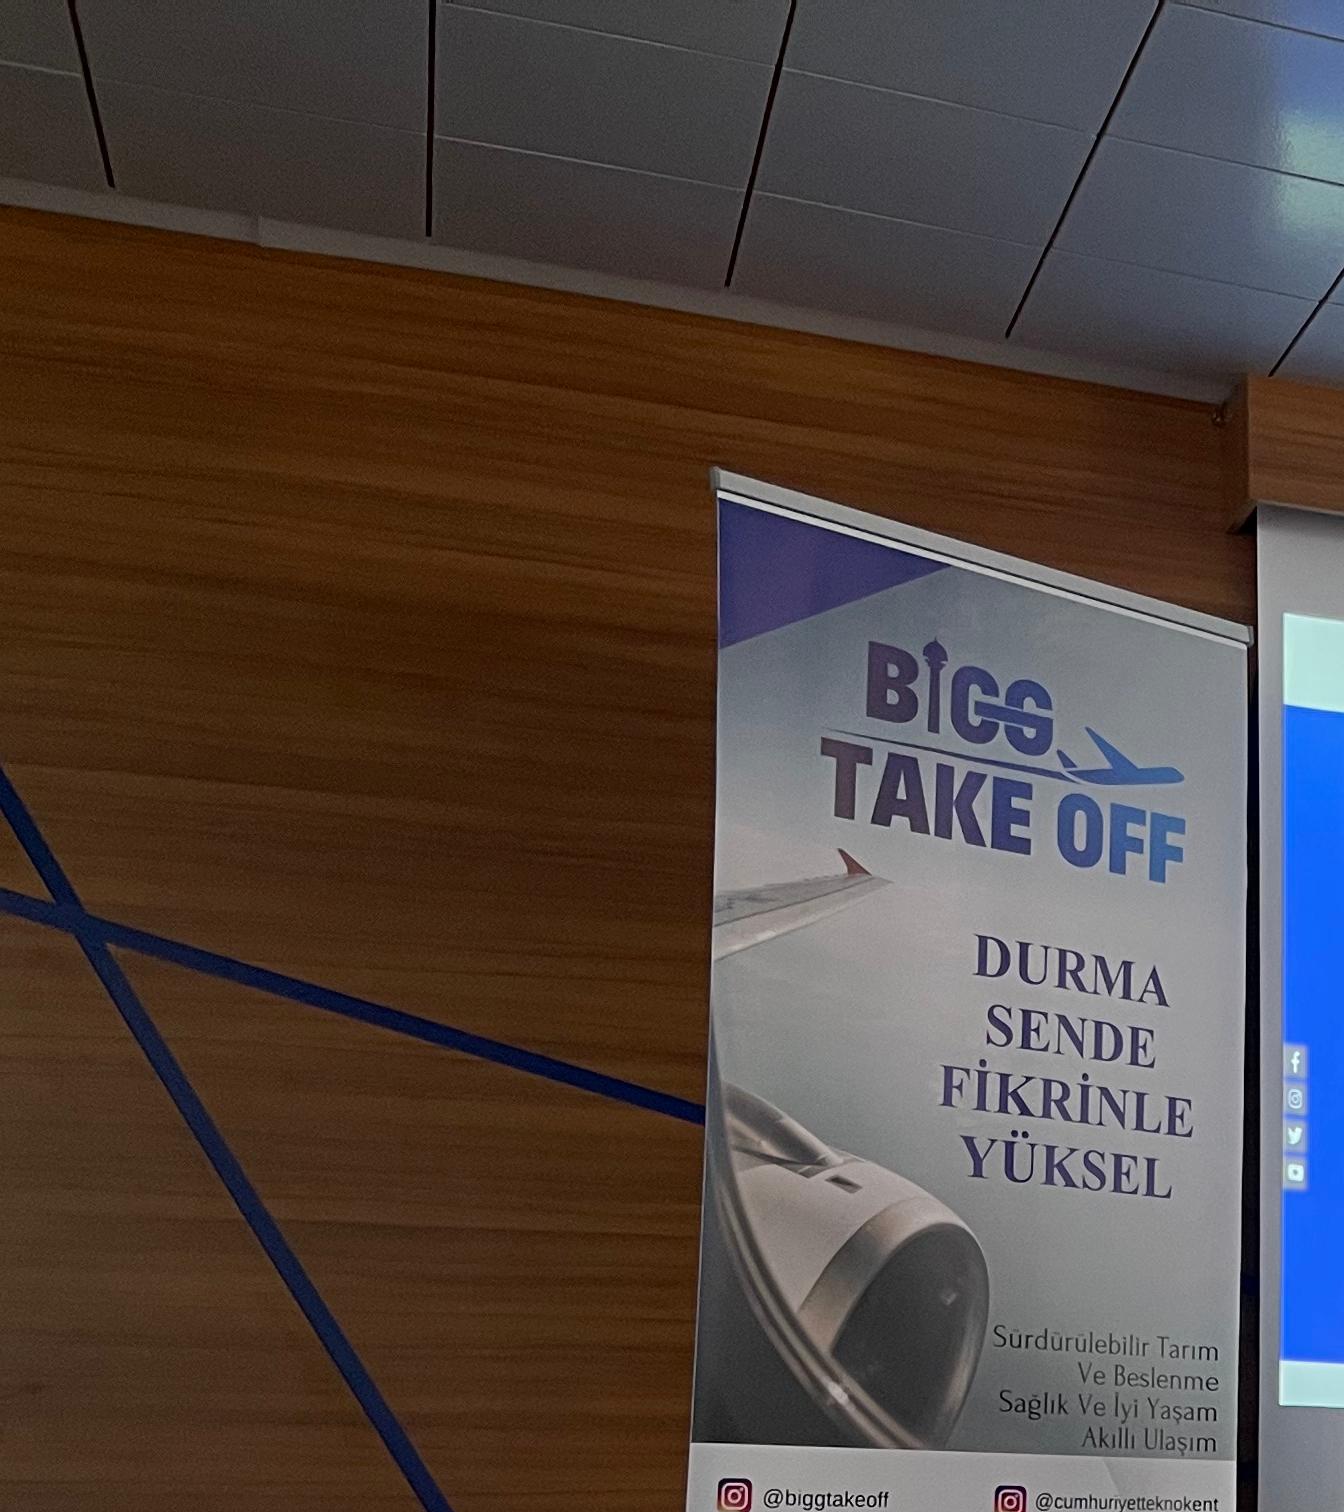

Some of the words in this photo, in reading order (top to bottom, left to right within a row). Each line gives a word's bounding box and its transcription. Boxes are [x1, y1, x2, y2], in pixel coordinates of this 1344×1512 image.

[820, 737, 1033, 856] TAKE
[1057, 793, 1186, 884] OFF
[972, 933, 1170, 1007] DURMA
[986, 1004, 1156, 1068] SENDE
[938, 1059, 1193, 1137] FİKRİNLE
[960, 1130, 1173, 1199] YÜKSEL
[993, 1324, 1150, 1357] Sürdürülebilir
[1156, 1336, 1219, 1361] Tarım
[1078, 1361, 1106, 1385] Ve
[1114, 1364, 1219, 1391] Beslenme
[999, 1389, 1069, 1421] Sağlık
[1079, 1393, 1106, 1417] Ve
[1148, 1397, 1217, 1424] Yaşam
[1081, 1426, 1135, 1450] Akıllı
[1144, 1427, 1217, 1456] Ulaşım
[762, 1487, 890, 1511] @biggtakeoff
